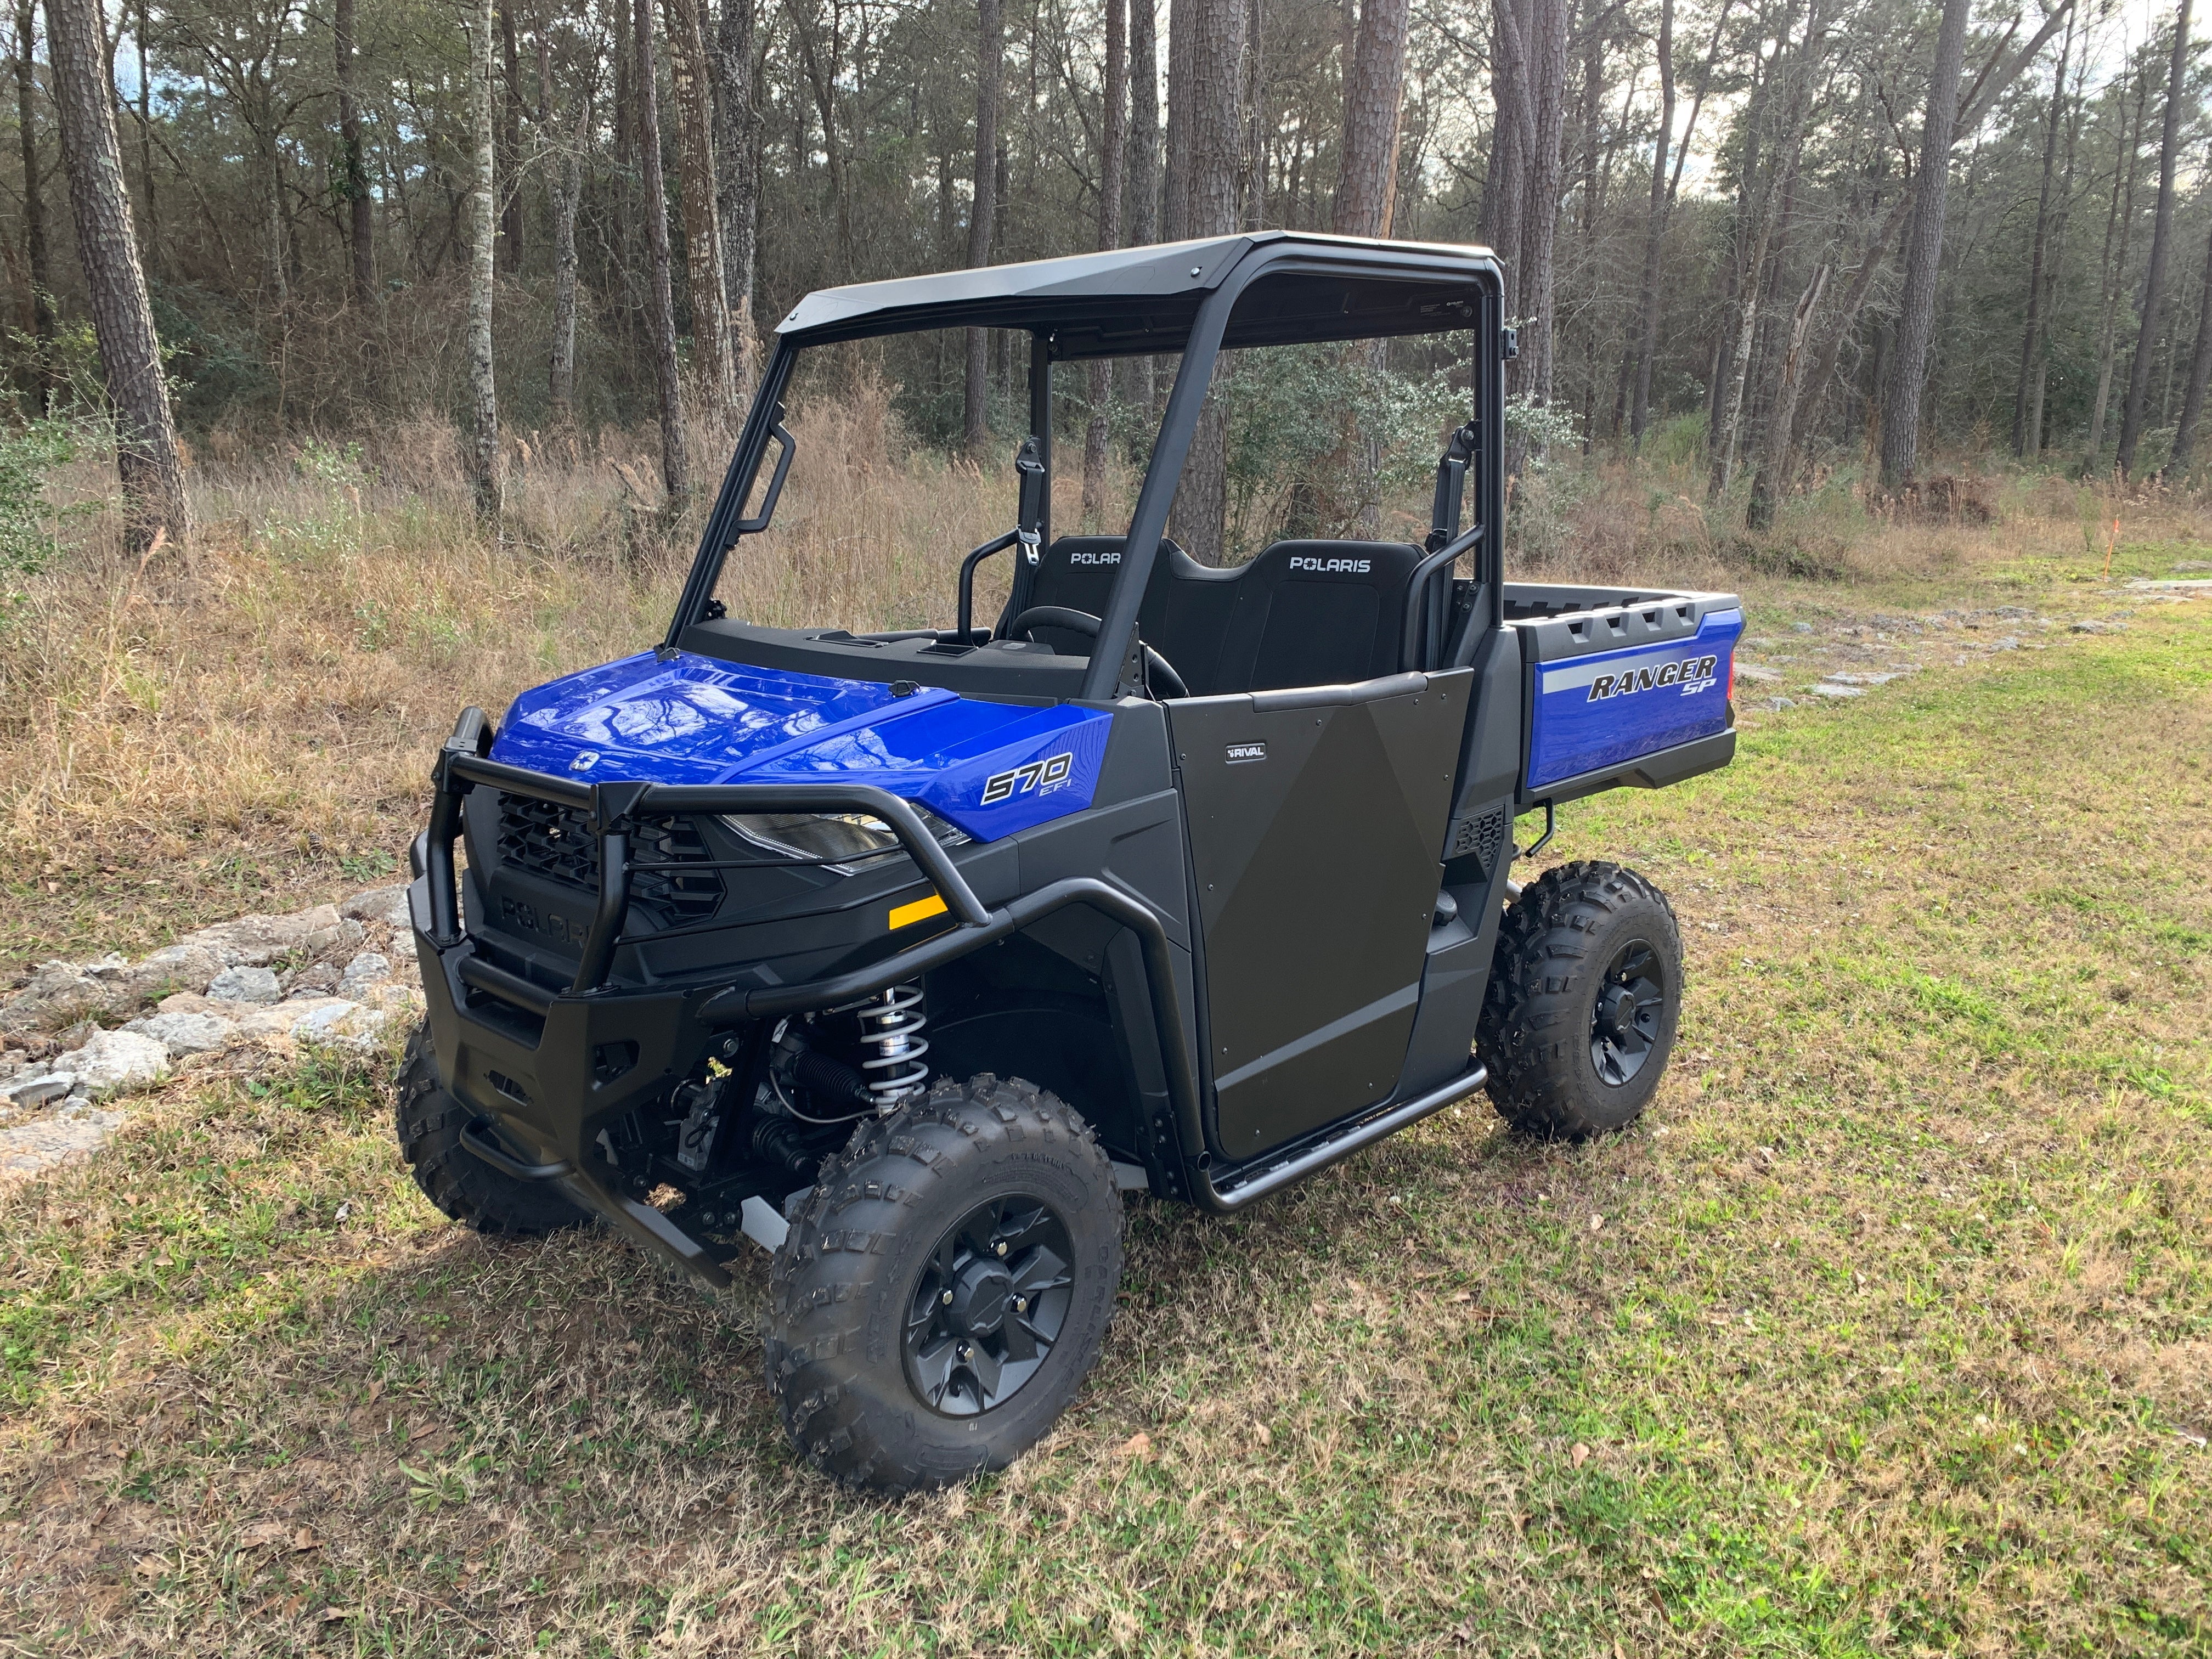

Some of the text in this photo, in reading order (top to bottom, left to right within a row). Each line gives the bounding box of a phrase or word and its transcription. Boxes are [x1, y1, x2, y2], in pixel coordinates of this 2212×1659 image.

[1289, 556, 1371, 573] POLARIS
[1587, 654, 1718, 703] RANGER
[1680, 678, 1717, 696] SP
[1234, 747, 1264, 758] RIVAL
[980, 751, 1073, 806] 570
[1039, 779, 1073, 797] EFI
[1062, 1246, 1109, 1392] CARLISLE
